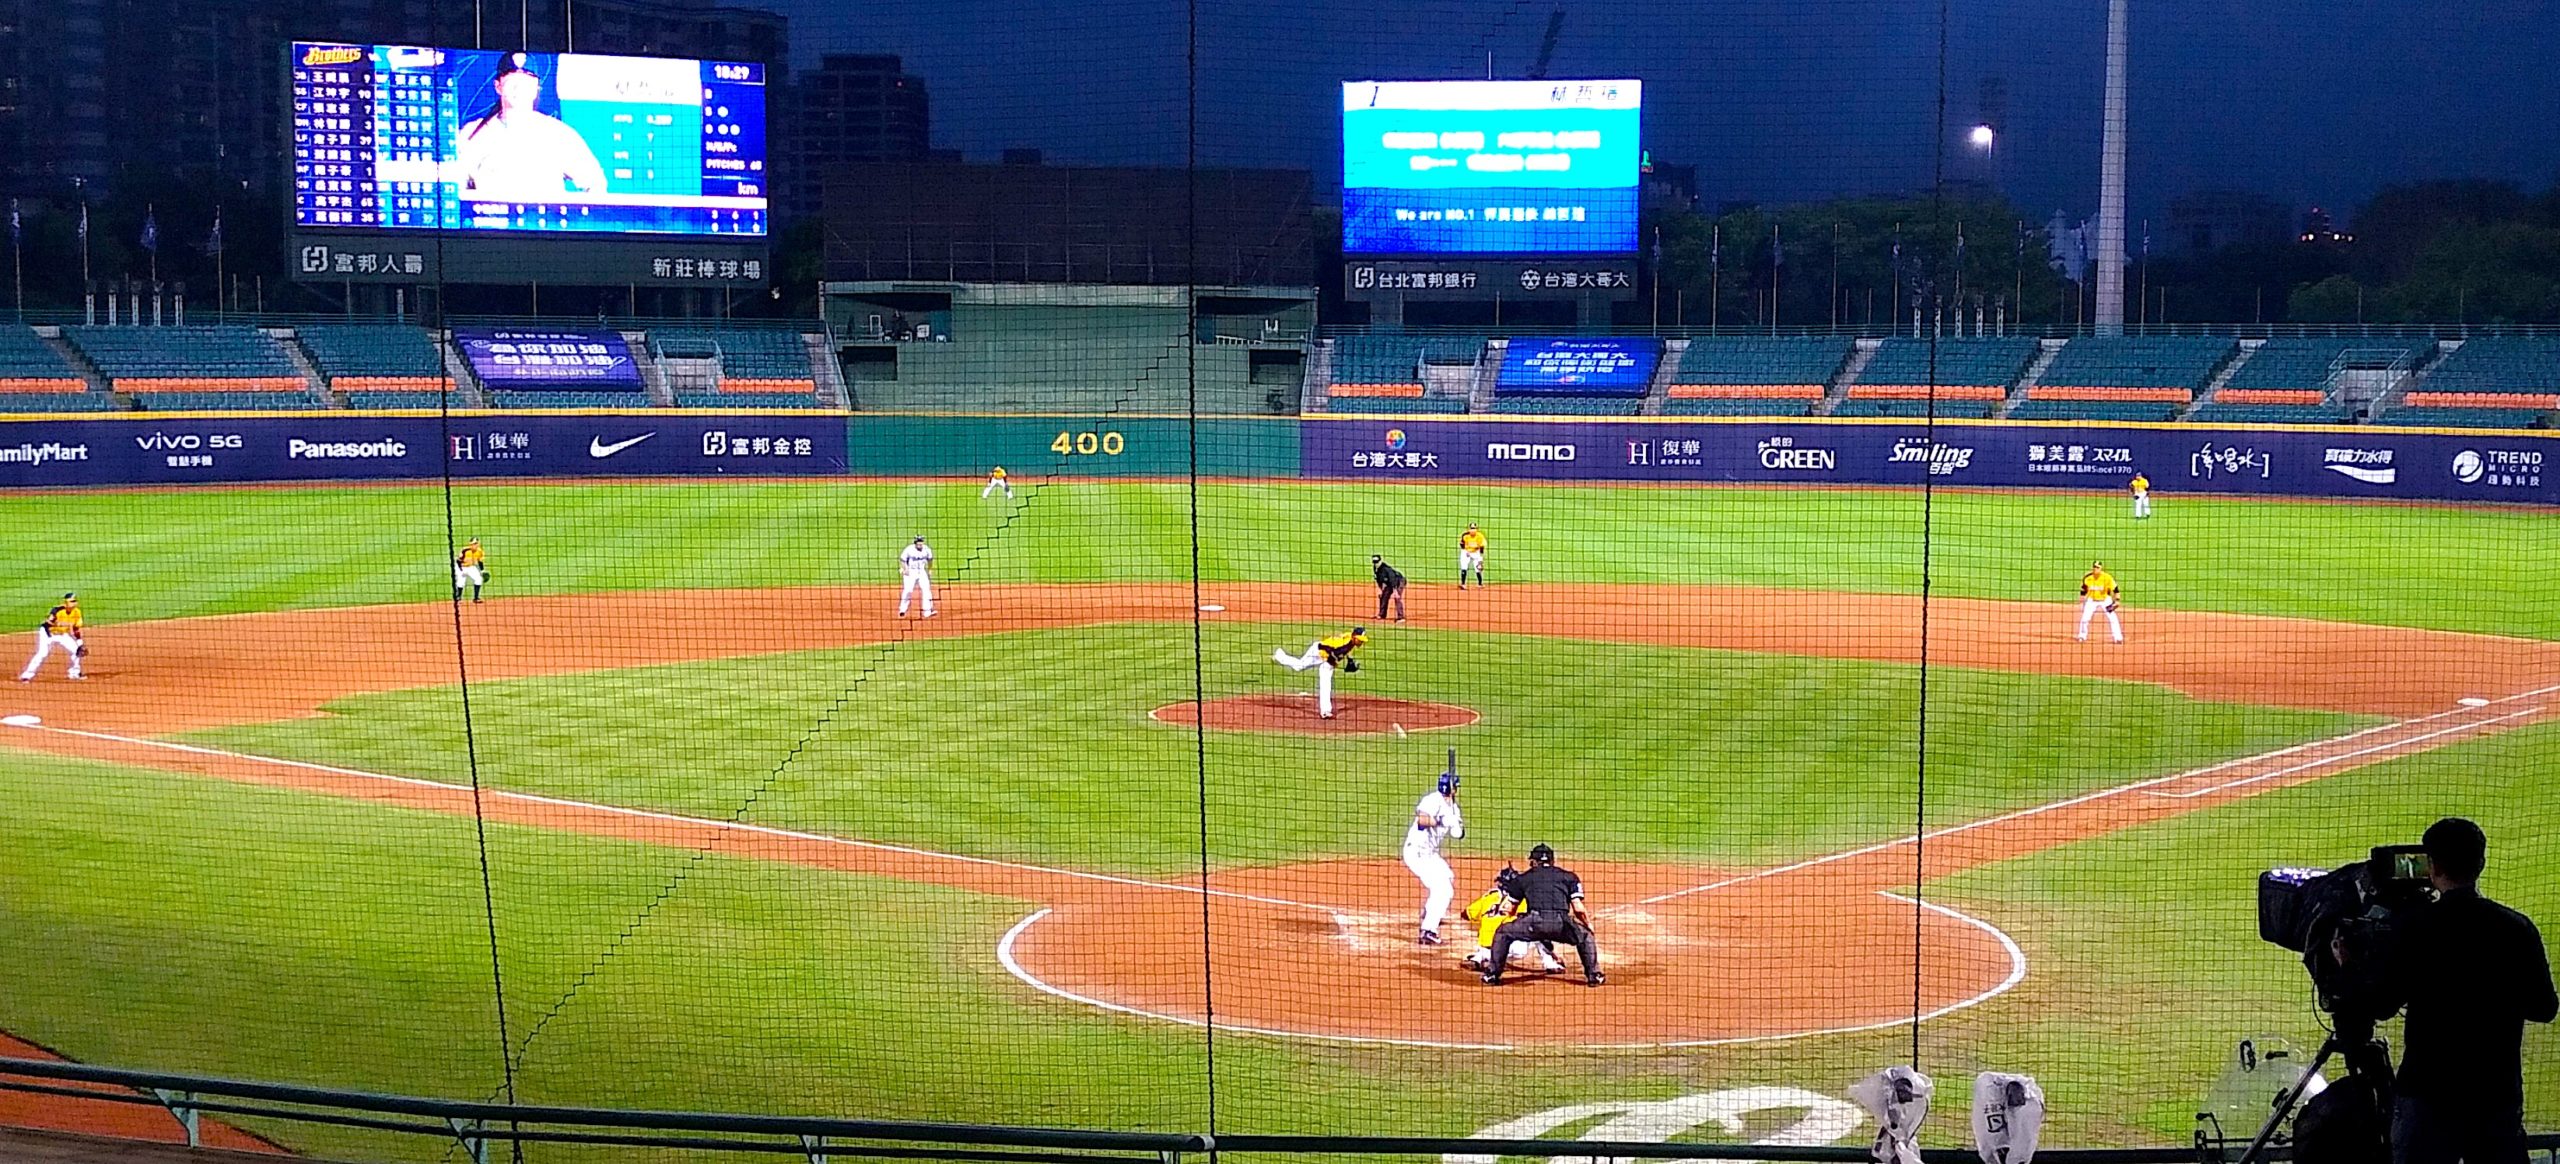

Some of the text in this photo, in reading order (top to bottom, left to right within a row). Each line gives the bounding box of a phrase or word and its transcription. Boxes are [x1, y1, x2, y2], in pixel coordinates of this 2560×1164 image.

[303, 47, 362, 65] Brothers
[738, 182, 758, 195] km
[1396, 209, 1416, 221] We
[1419, 210, 1441, 221] are
[334, 253, 424, 274] 富邦人壽
[653, 258, 761, 280] 新莊棒球場
[1378, 272, 1477, 288] 台北富邦銀行
[210, 435, 242, 448] 5G
[289, 439, 406, 459] Panasonic
[489, 432, 529, 449] 復華
[732, 437, 811, 456] 富邦金控
[1050, 432, 1125, 455] 400
[1662, 440, 1700, 456] 復華
[1488, 443, 1575, 460] momo
[1762, 448, 1834, 469] GREEN
[1888, 443, 1973, 467] Smiling
[2092, 448, 2132, 462] スマイル
[2325, 448, 2393, 464] 寶礦力水得
[2488, 451, 2542, 464] TREND
[2488, 465, 2540, 473] MICRO
